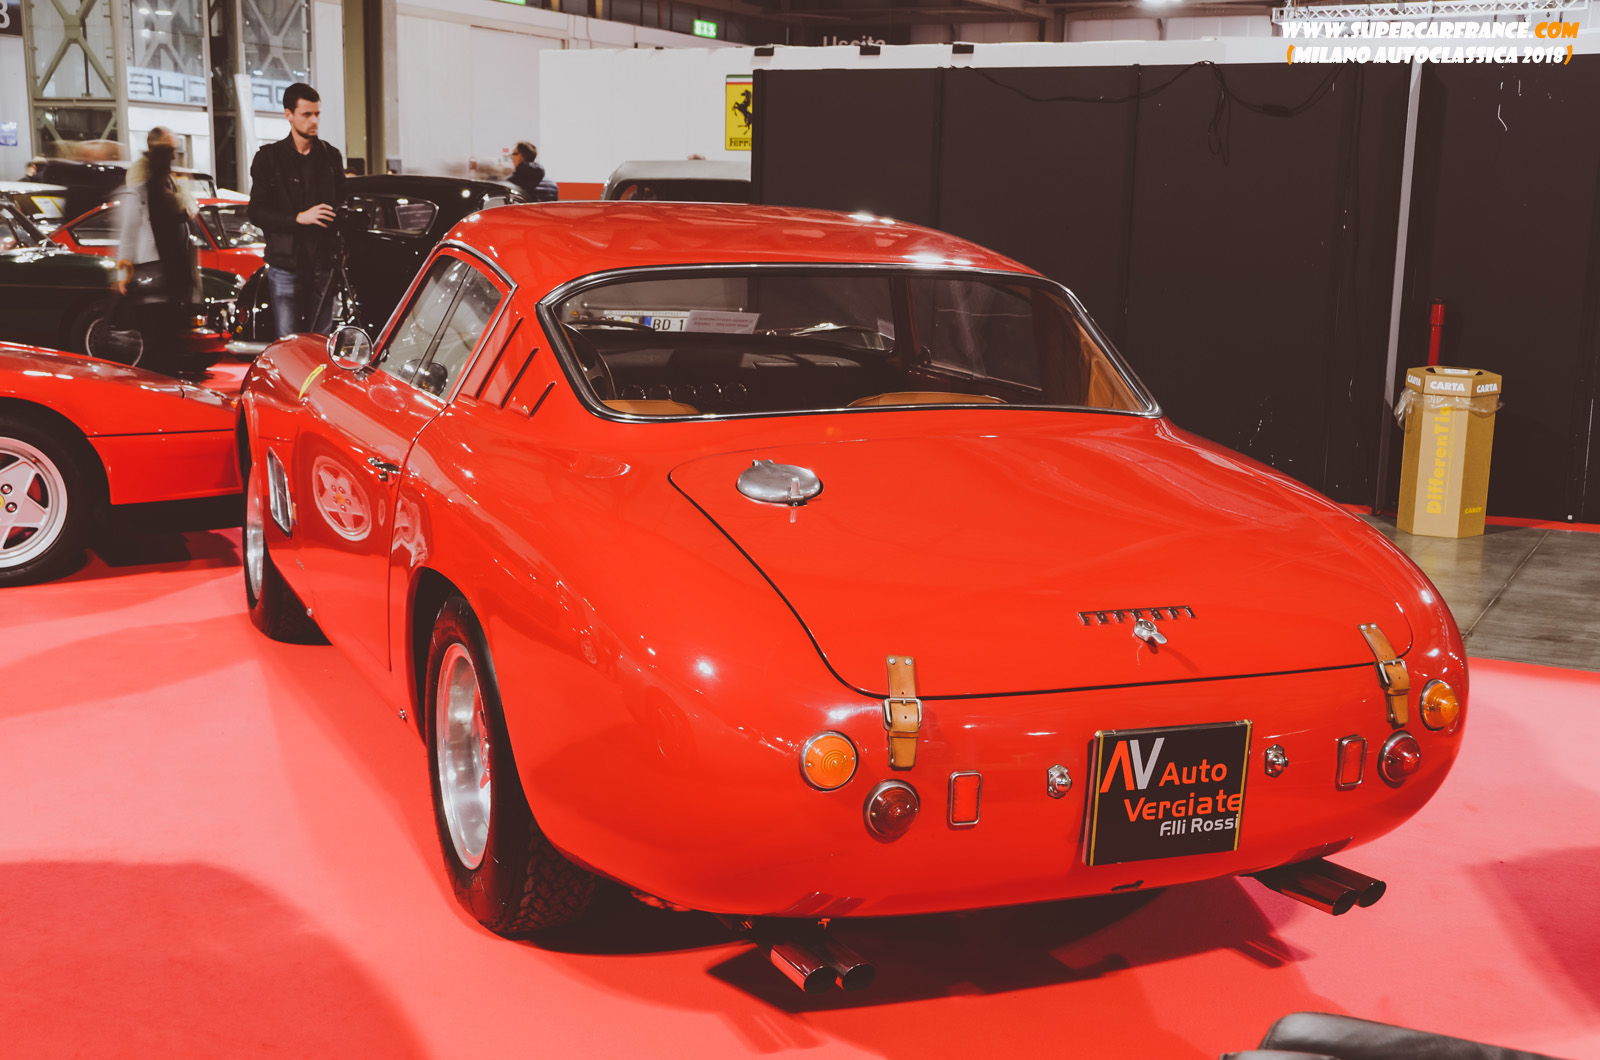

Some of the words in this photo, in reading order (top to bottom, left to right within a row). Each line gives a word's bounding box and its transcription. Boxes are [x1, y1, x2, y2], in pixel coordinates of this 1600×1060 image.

[653, 318, 671, 331] BD
[1408, 374, 1421, 387] CARTA
[1430, 381, 1465, 392] CARTA
[1476, 383, 1498, 393] CARTA
[1158, 759, 1227, 787] Auto
[1190, 814, 1239, 834] Rossi
